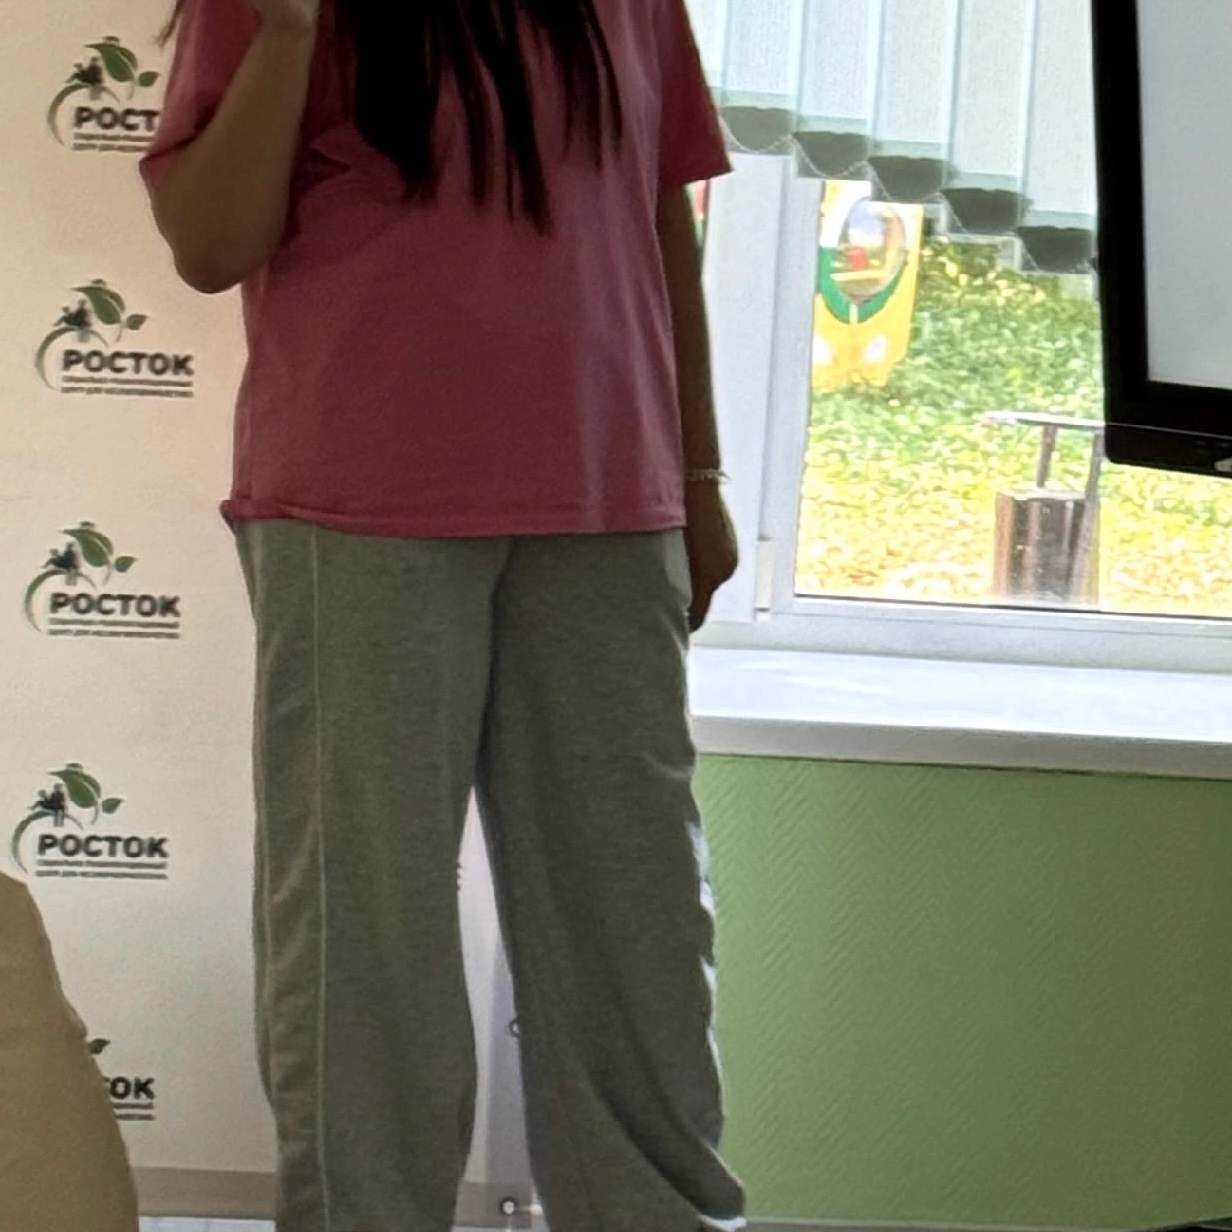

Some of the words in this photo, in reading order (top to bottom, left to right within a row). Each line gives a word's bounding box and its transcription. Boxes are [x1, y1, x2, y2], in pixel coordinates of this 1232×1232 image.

[62, 348, 195, 376] РОСТОК
[49, 592, 181, 618] РОСТОК
[37, 833, 169, 859] РОСТОК
